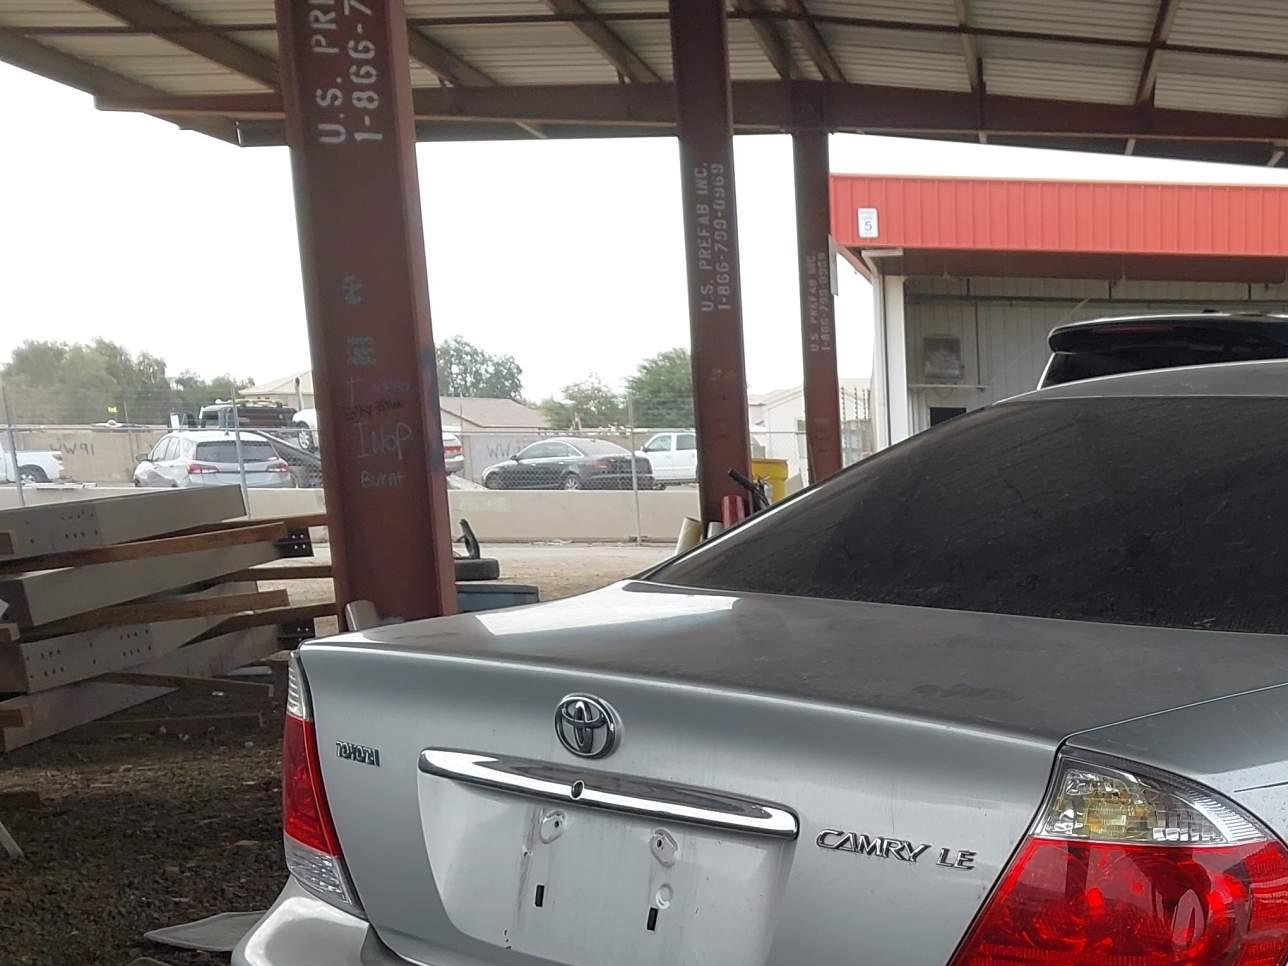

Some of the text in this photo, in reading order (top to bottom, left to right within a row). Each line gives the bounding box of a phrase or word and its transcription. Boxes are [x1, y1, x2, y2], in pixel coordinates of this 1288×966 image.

[308, 0, 347, 143] U.S. PR
[694, 162, 715, 311] U.S. PREFAB INC.
[864, 220, 873, 232] 5
[816, 828, 977, 870] CAMRY LE
